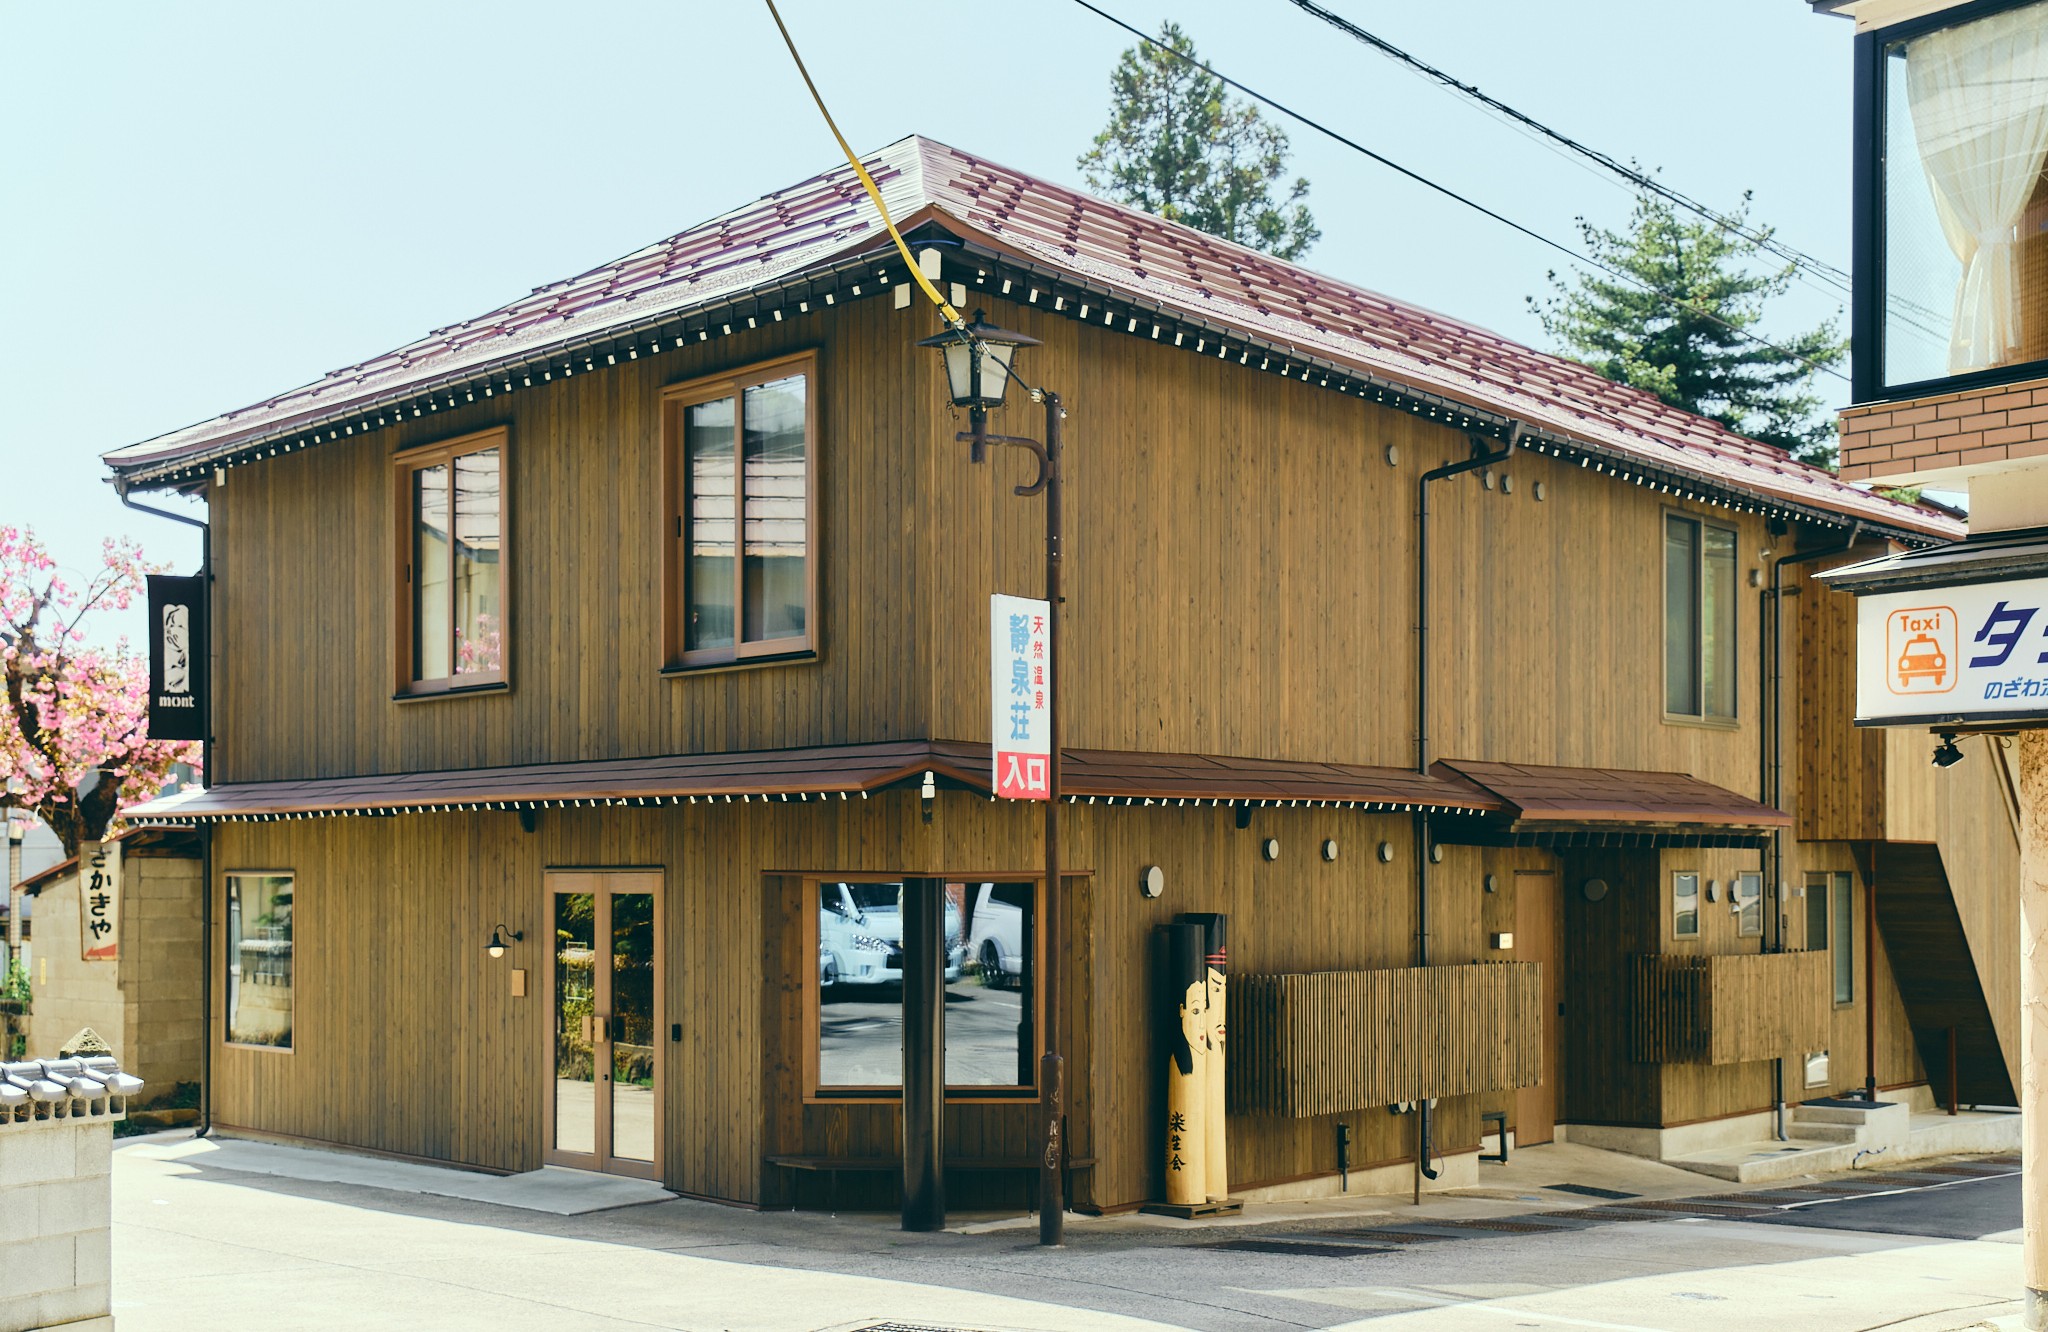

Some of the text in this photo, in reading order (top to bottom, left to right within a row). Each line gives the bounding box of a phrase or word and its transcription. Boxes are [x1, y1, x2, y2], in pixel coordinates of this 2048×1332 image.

[1900, 613, 1940, 632] Taxi
[1969, 601, 2048, 668] タ
[1009, 613, 1031, 741] 静泉荘
[1033, 616, 1045, 710] 天然温泉
[159, 695, 195, 708] mont
[1002, 755, 1046, 792] 入口
[89, 846, 112, 940] さかきや
